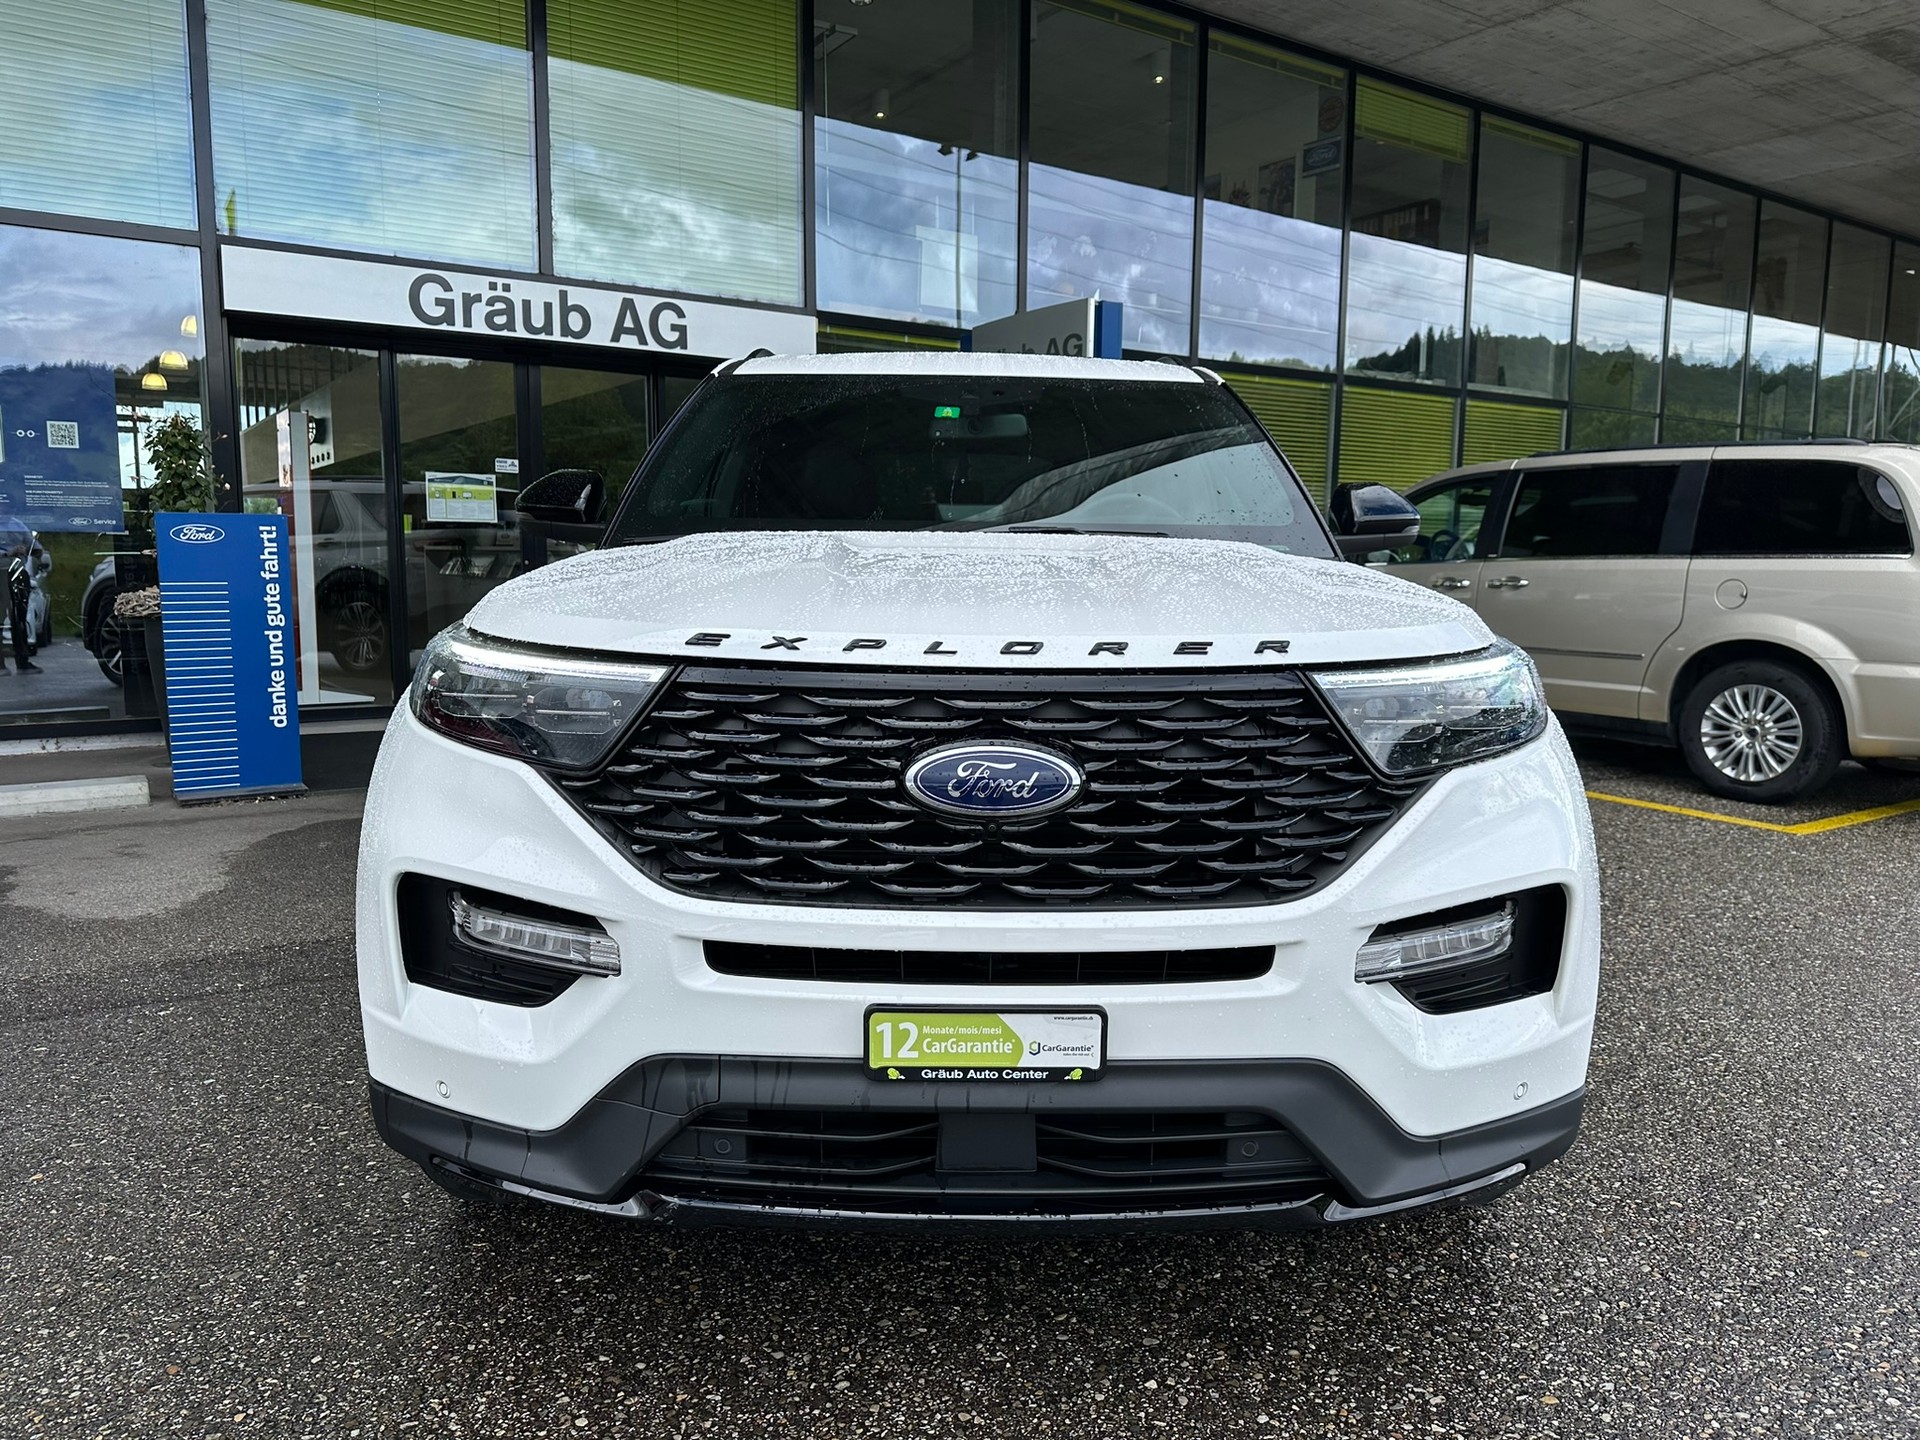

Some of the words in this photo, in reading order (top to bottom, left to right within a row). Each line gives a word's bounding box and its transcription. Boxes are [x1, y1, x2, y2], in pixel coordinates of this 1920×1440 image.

[408, 273, 592, 339] Gräub
[610, 297, 689, 350] AG
[1045, 333, 1084, 357] AG
[179, 526, 216, 542] Ford
[258, 525, 280, 580] fahrt!
[264, 583, 286, 627] gute
[264, 629, 286, 667] und
[684, 632, 1291, 657] EXPLORER
[268, 668, 288, 728] danke
[947, 760, 1041, 798] Ford
[875, 1022, 919, 1059] 12
[920, 1069, 964, 1079] Gräub
[966, 1069, 999, 1079] Auto
[1002, 1069, 1049, 1079] Center
